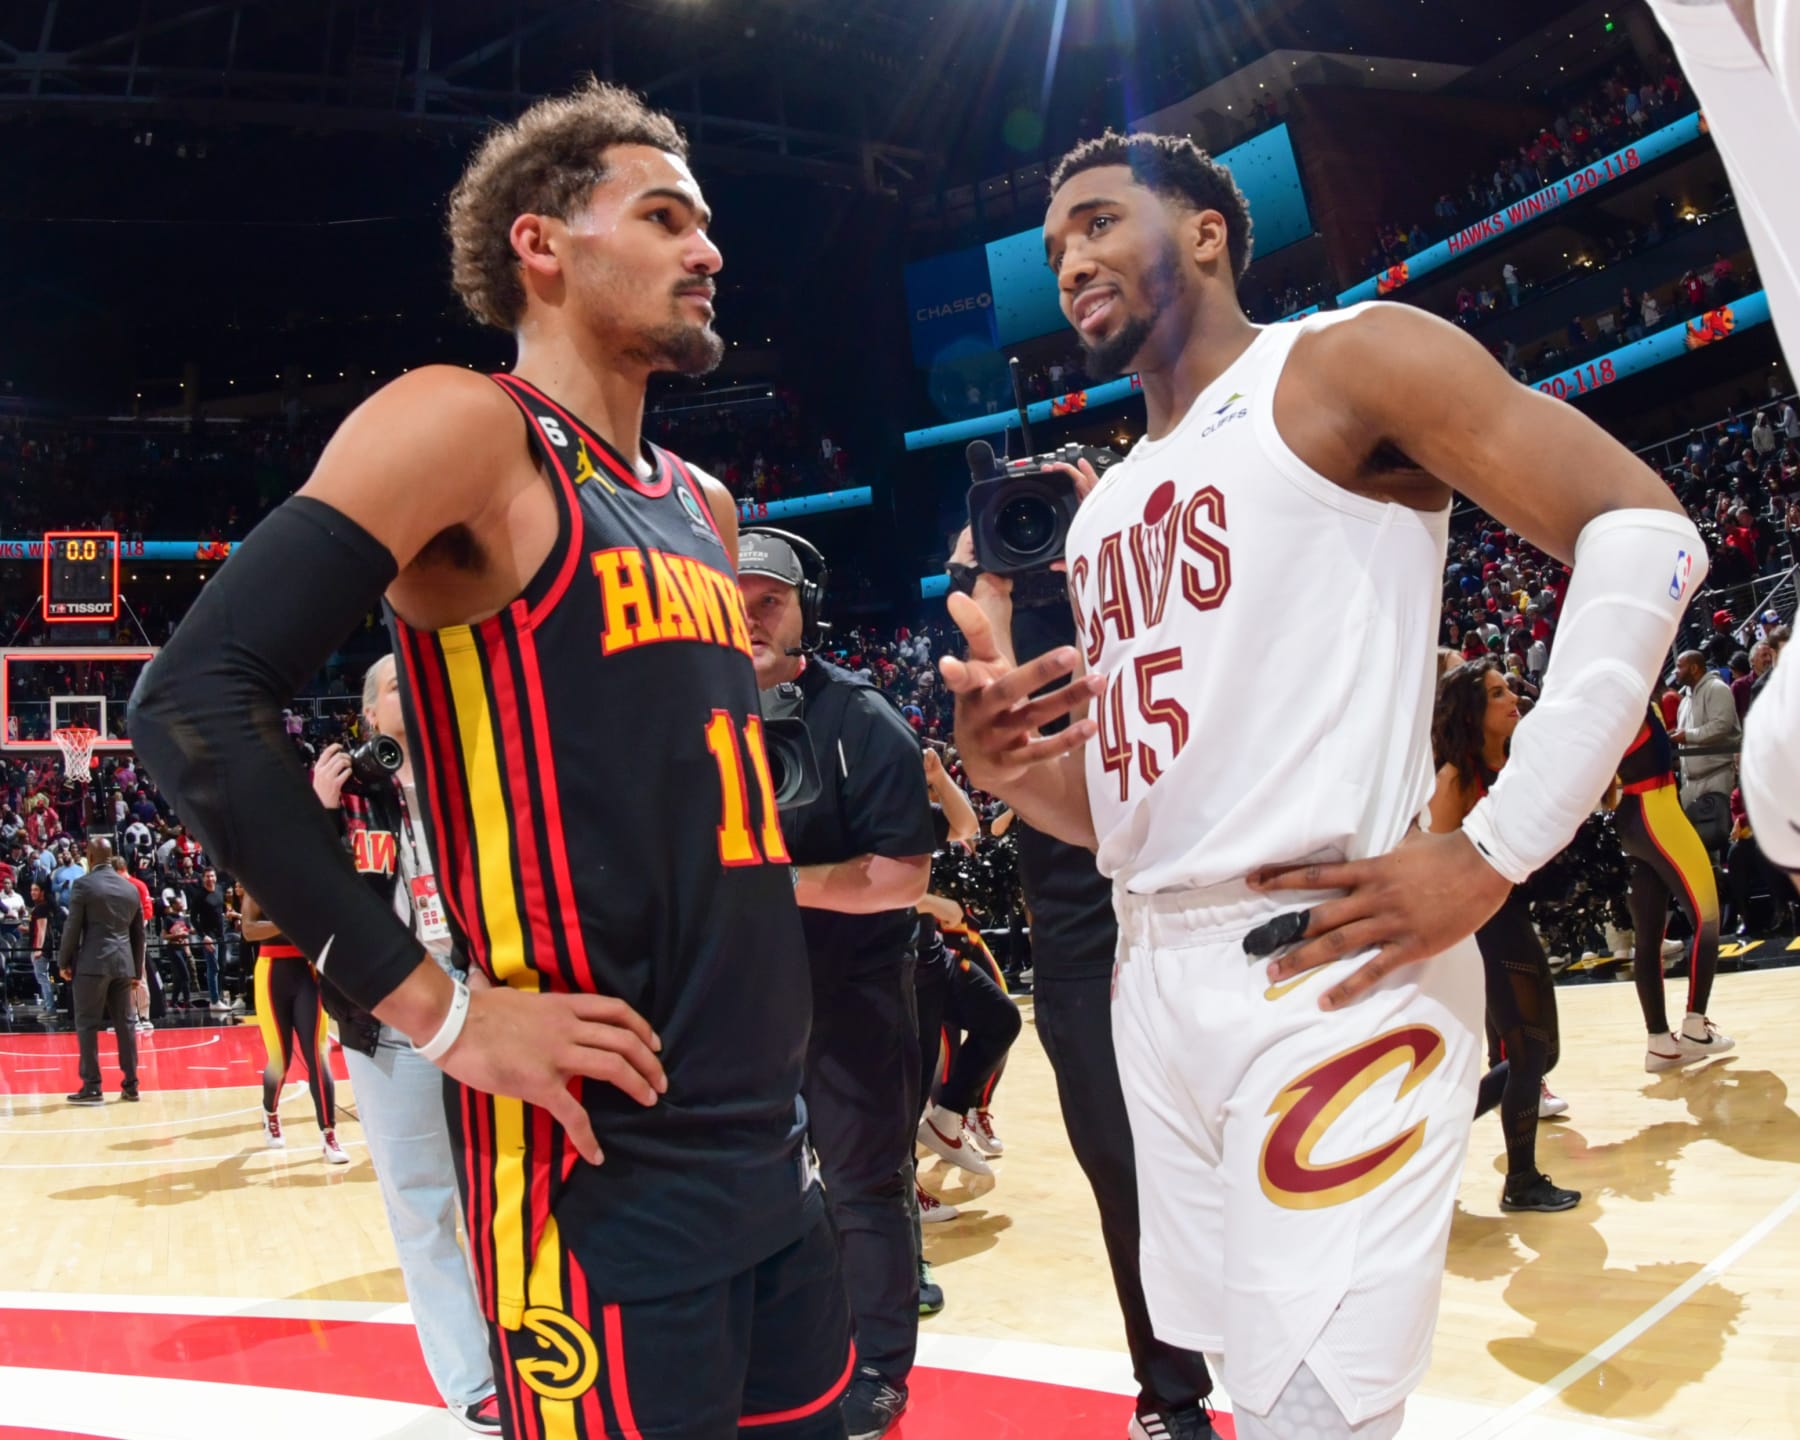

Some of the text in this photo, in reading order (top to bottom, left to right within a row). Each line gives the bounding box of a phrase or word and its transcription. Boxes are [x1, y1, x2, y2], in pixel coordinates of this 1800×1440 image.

[1447, 147, 1641, 255] HAWKS WIN!!! 120-118
[916, 296, 977, 321] CHASE
[537, 415, 569, 448] 6
[1201, 408, 1248, 438] CLIFFS
[66, 539, 96, 561] 0.0
[1069, 482, 1232, 667] CAVS
[67, 603, 112, 613] TISSOT
[1096, 646, 1190, 802] 45
[704, 708, 792, 868] 11
